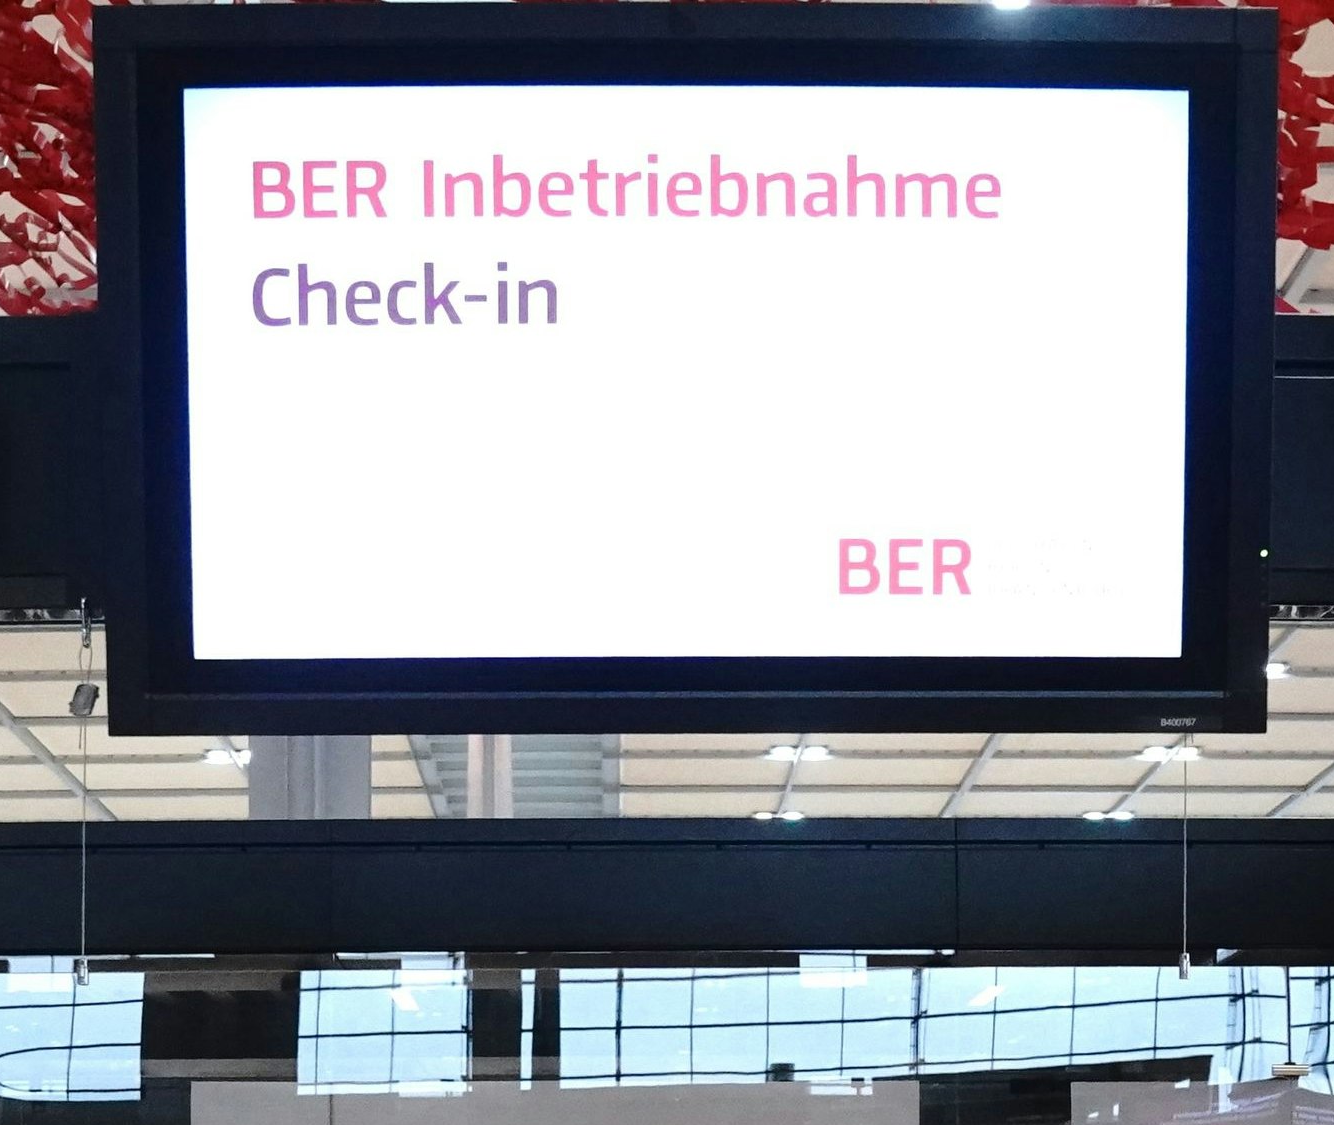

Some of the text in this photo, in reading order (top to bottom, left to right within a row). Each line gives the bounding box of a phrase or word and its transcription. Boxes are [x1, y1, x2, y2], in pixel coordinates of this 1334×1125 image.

[252, 153, 1002, 220] BER Inbetriebnahme
[252, 261, 559, 327] Check-in
[839, 538, 972, 596] BER
